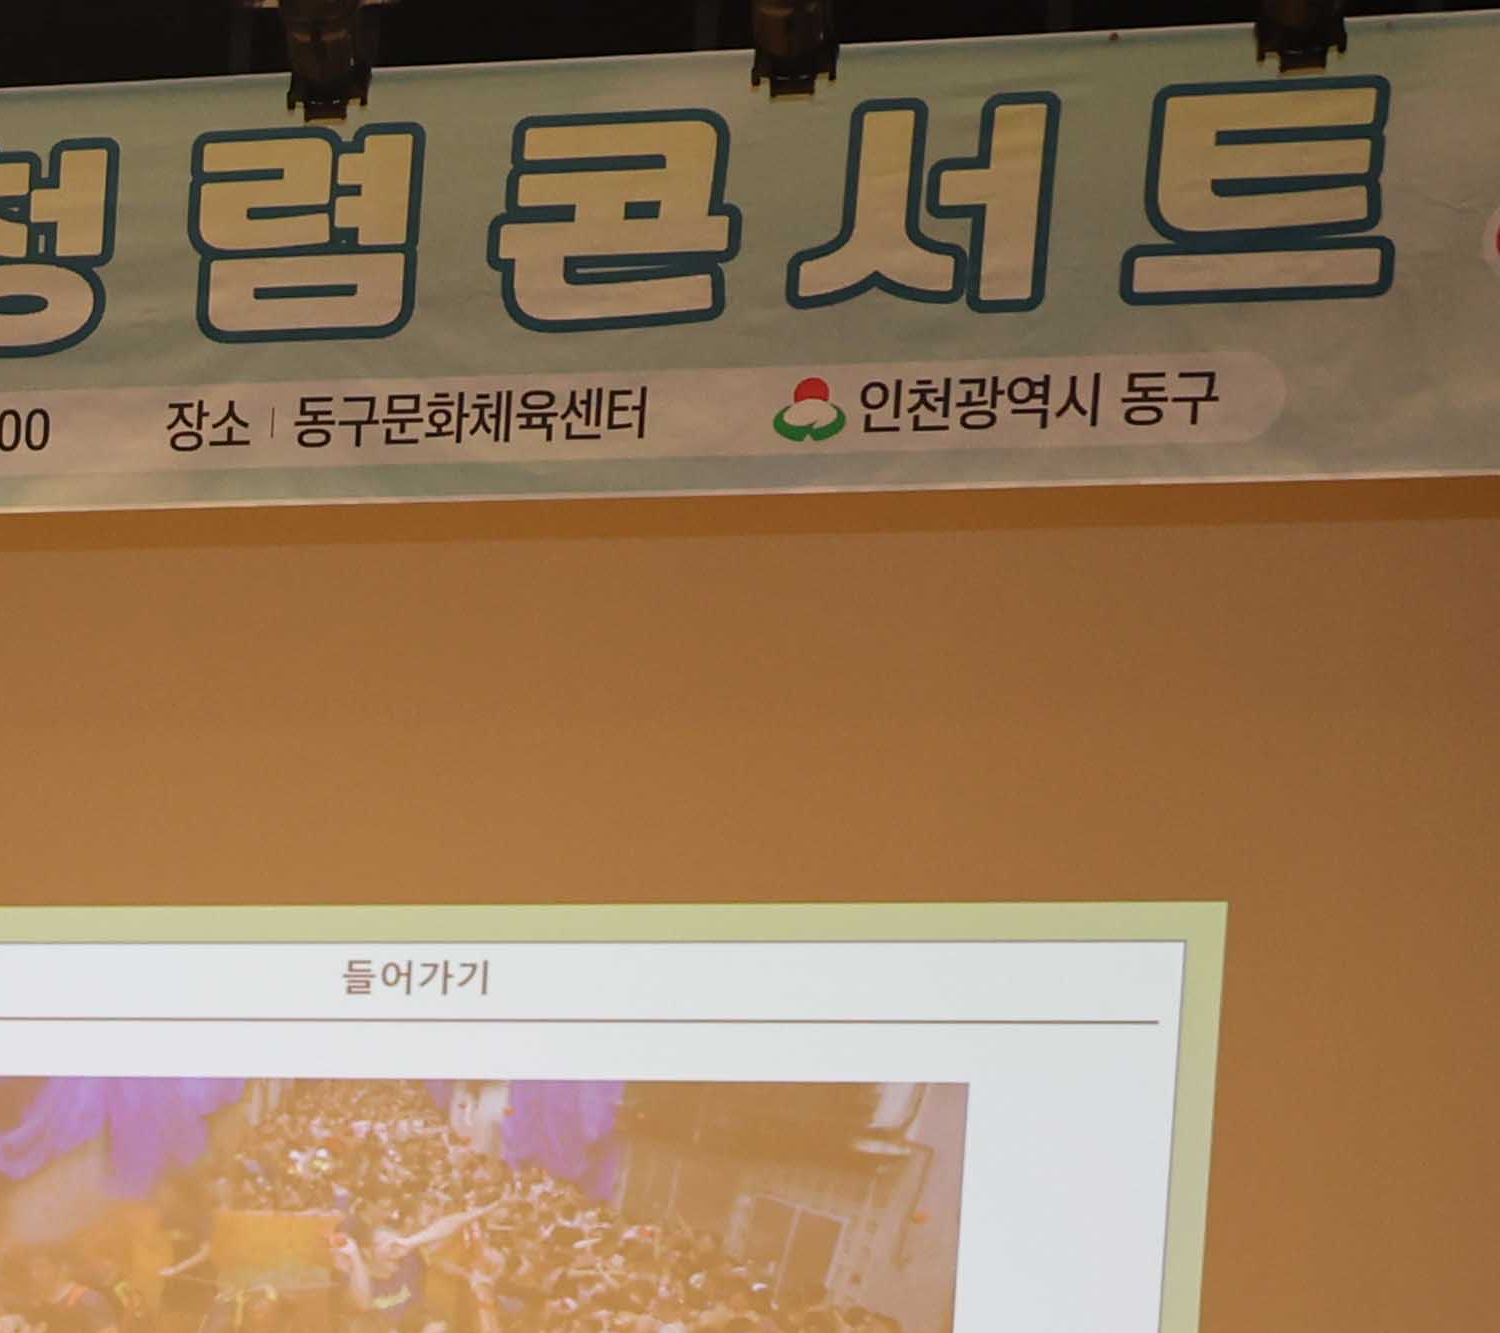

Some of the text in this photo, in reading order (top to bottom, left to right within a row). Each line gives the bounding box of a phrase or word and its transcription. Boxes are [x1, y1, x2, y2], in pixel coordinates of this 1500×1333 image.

[166, 386, 648, 452] 장소 동구문화체육센터
[859, 371, 1220, 433] 인천광역시 동구
[342, 959, 489, 995] 들어가기
